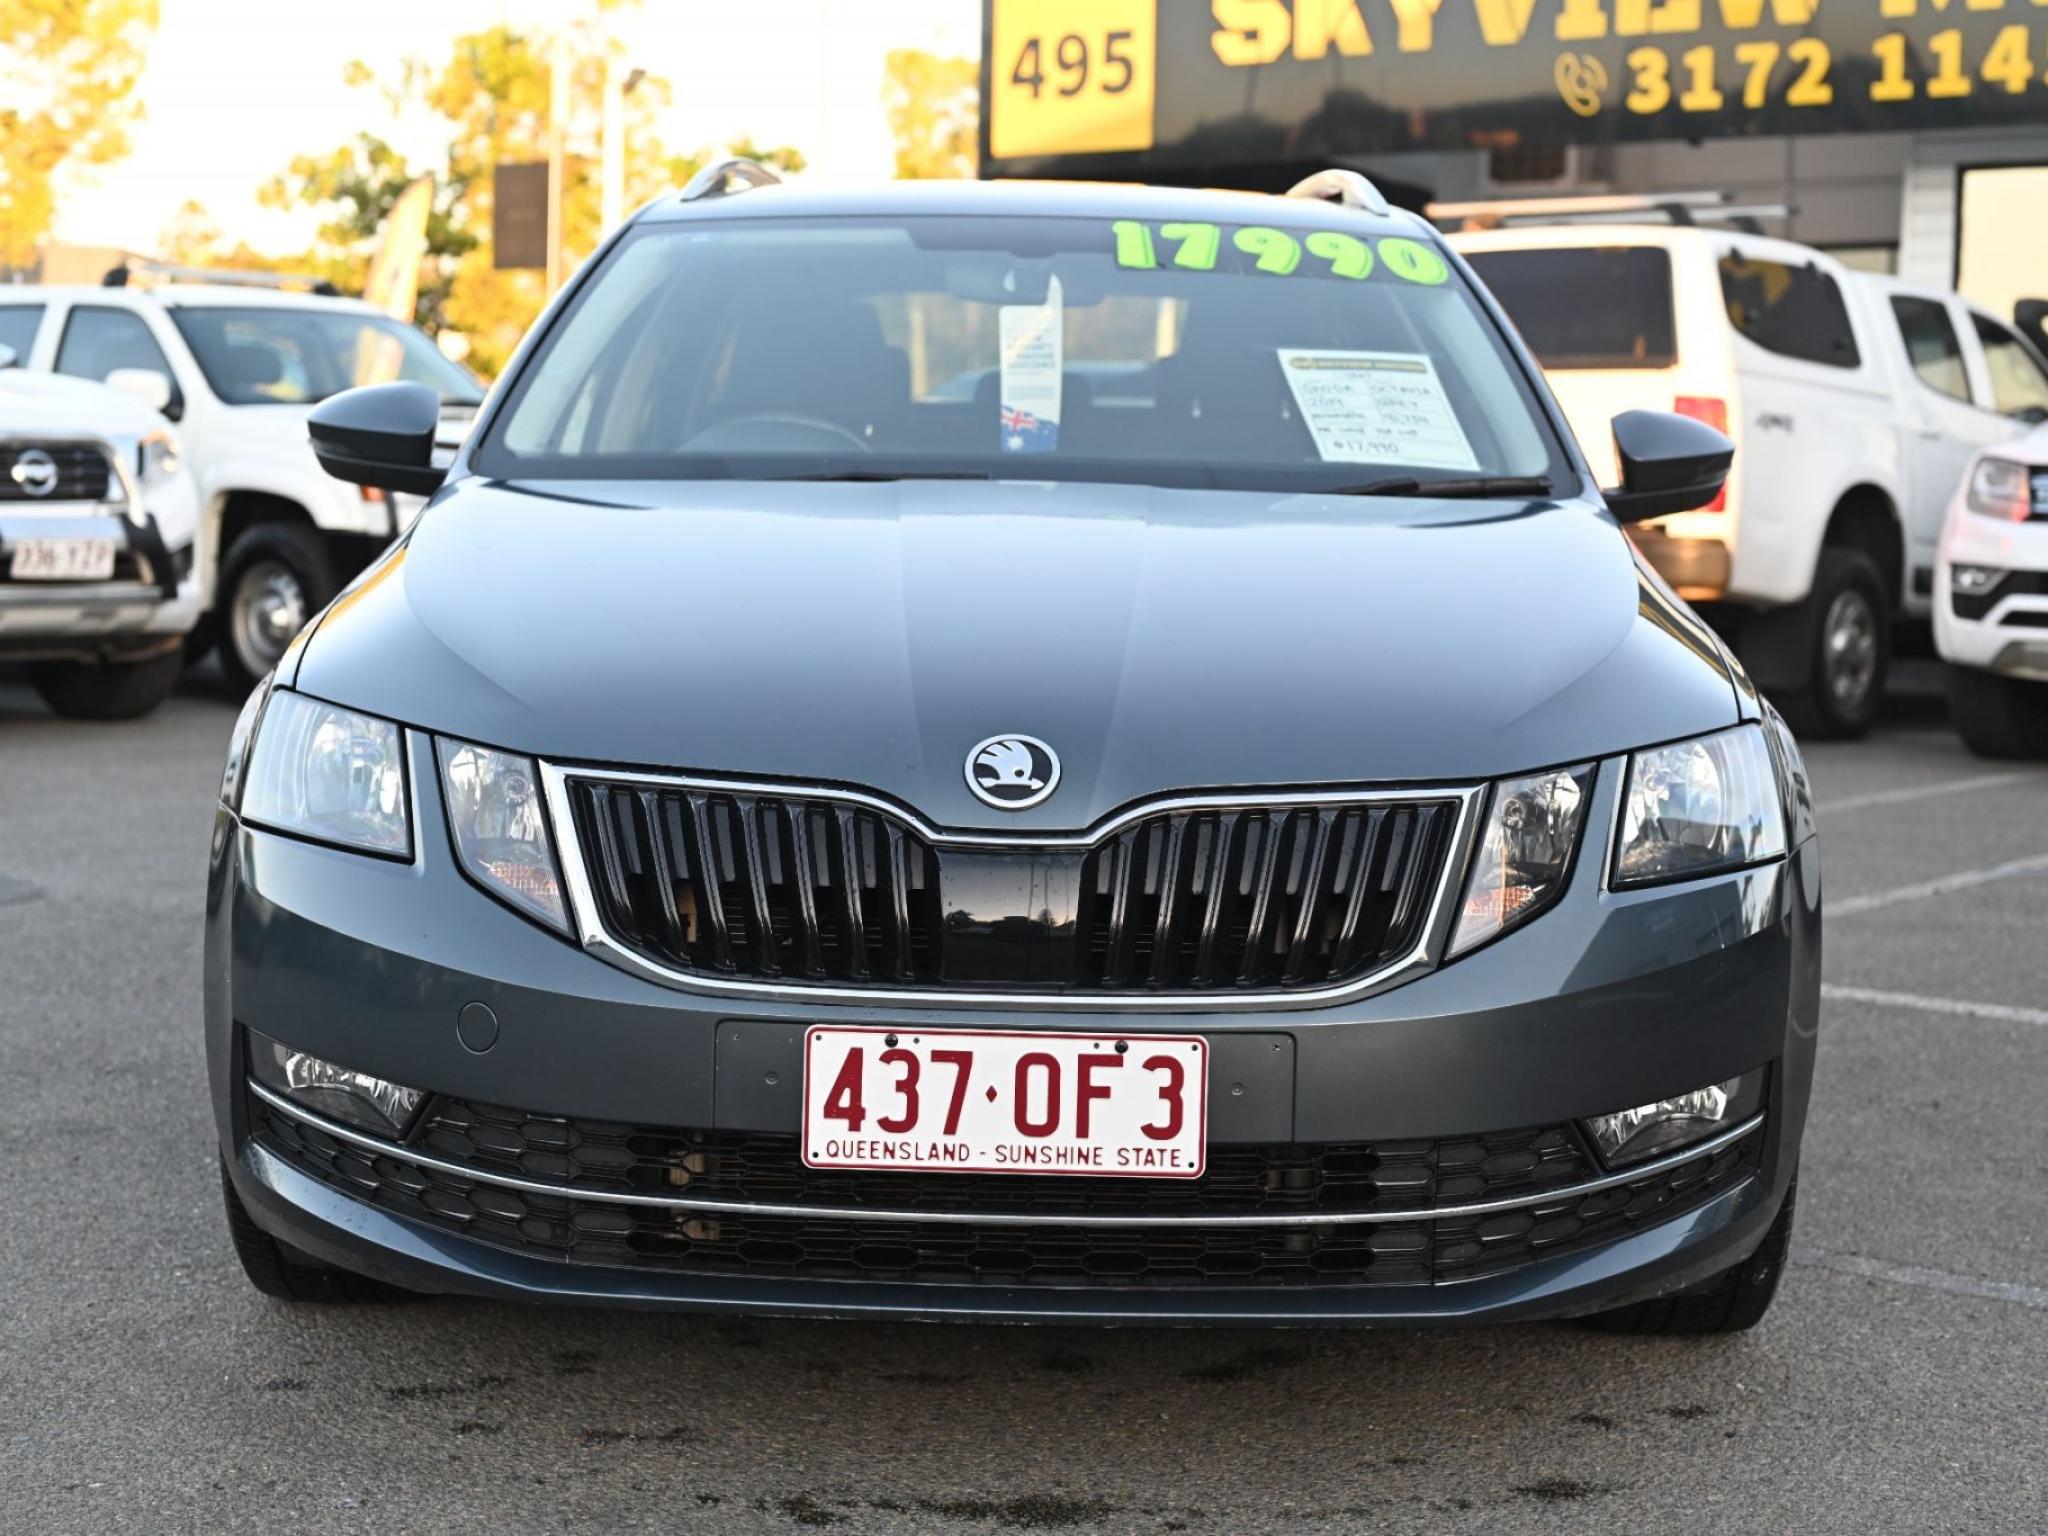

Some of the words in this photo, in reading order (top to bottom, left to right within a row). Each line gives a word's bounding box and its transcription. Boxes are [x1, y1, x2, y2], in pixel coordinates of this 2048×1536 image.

[1012, 30, 1134, 99] 495
[1210, 0, 1820, 67] SKYV
[1625, 37, 1833, 114] 3172
[1869, 24, 2048, 101] 114
[1112, 220, 1449, 286] 17990
[826, 1139, 971, 1163] QUEENSLAND
[994, 1144, 1103, 1166] SUNSHINE
[1116, 1147, 1182, 1168] STATE
